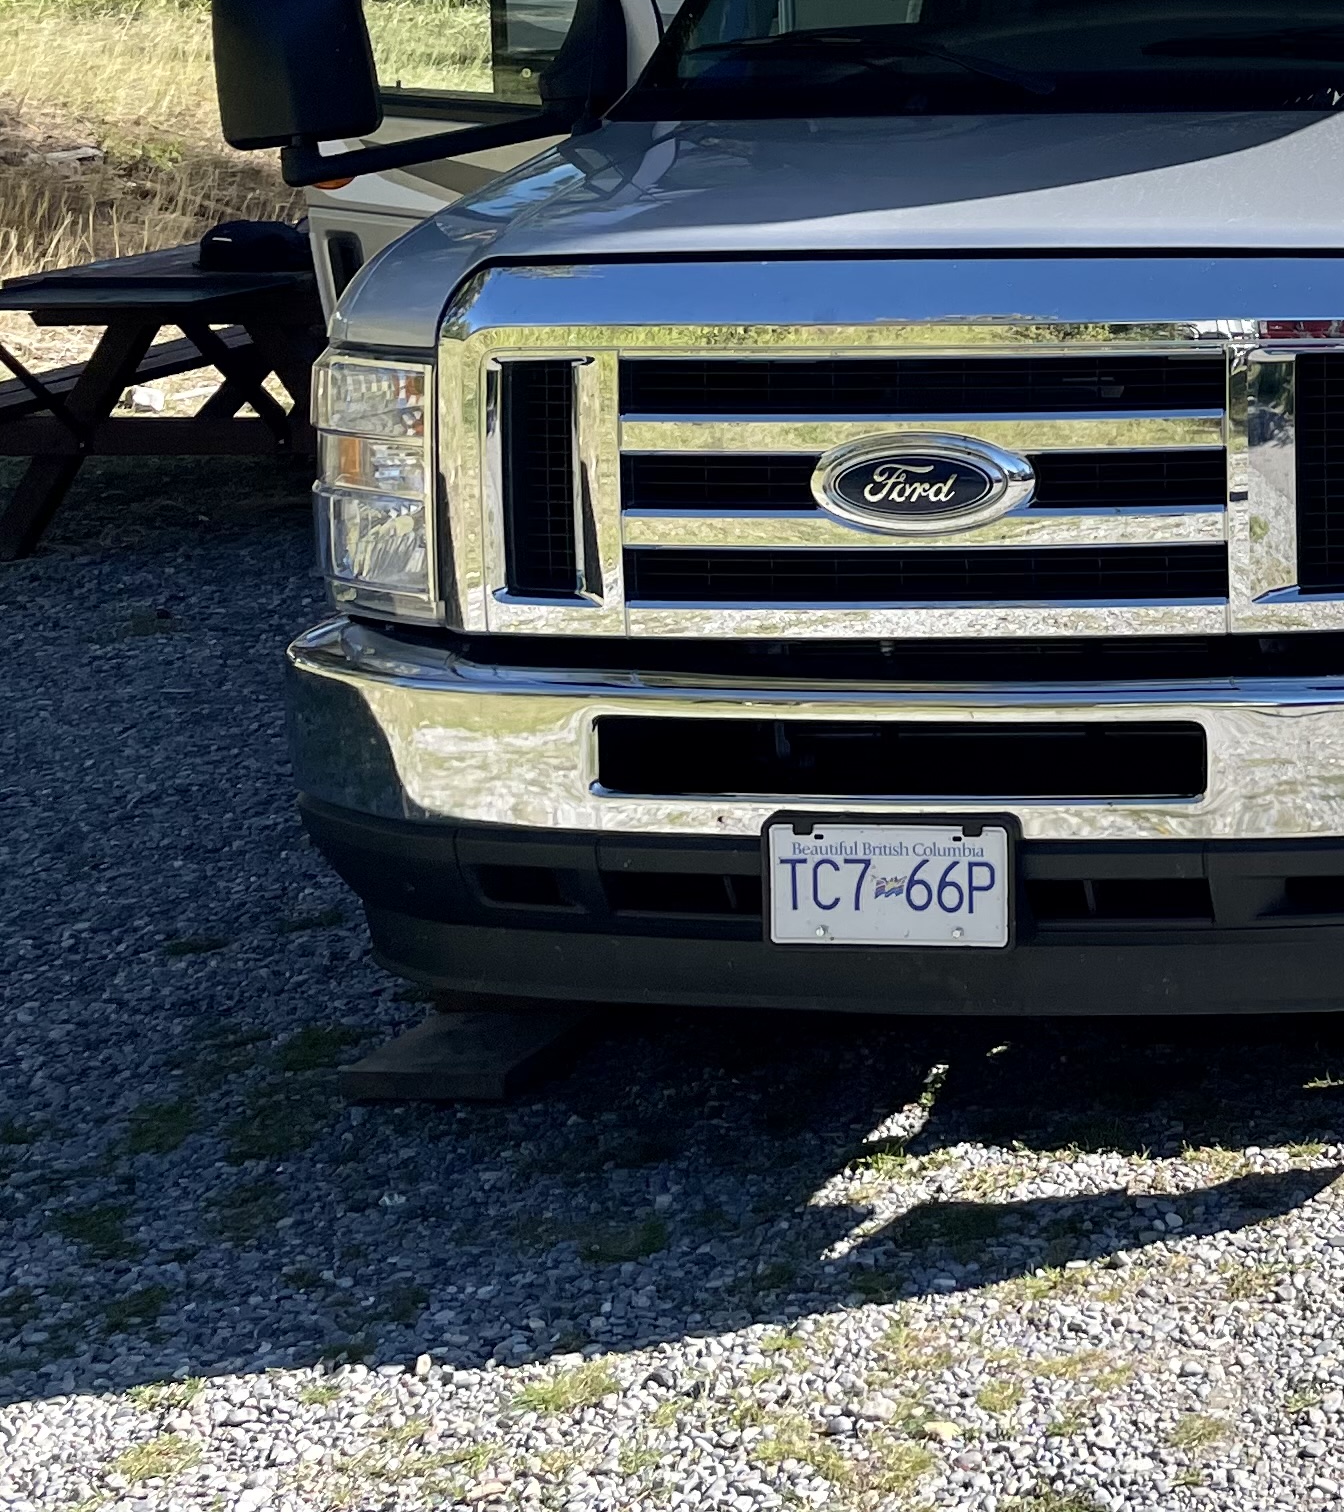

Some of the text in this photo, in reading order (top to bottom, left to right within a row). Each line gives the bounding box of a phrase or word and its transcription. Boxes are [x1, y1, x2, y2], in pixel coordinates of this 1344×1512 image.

[863, 463, 958, 503] Ford
[791, 841, 985, 858] Beautiful British Columbia
